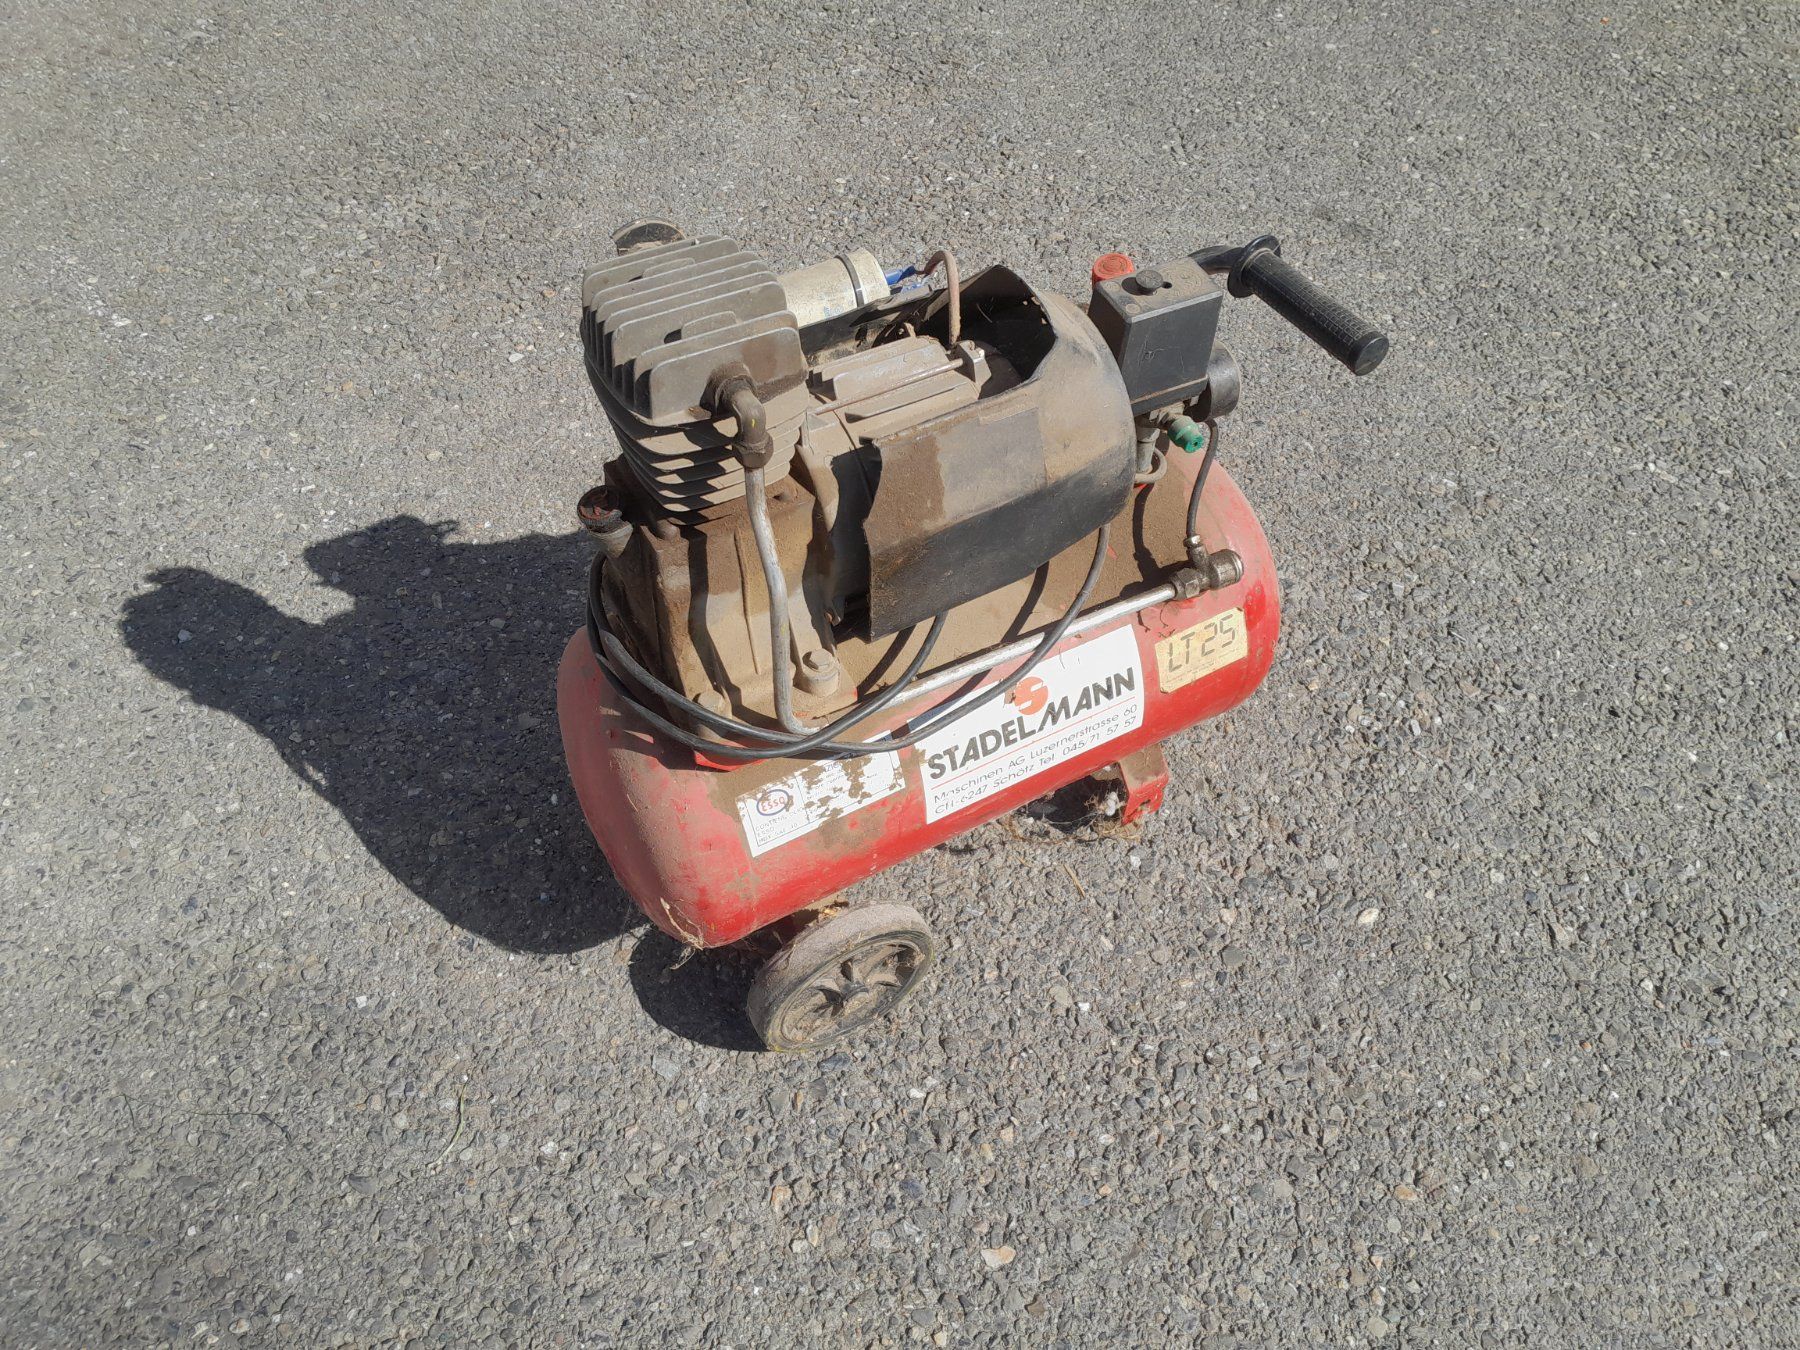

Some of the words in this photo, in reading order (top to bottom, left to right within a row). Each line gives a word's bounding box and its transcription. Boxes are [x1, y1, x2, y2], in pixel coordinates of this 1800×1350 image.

[928, 667, 1135, 779] STADELMANN
[1008, 755, 1026, 769] AG
[1031, 714, 1119, 759] Luzernerstrasse
[1123, 704, 1137, 717] 60
[1106, 724, 1119, 736] 57
[1124, 716, 1137, 728] 57
